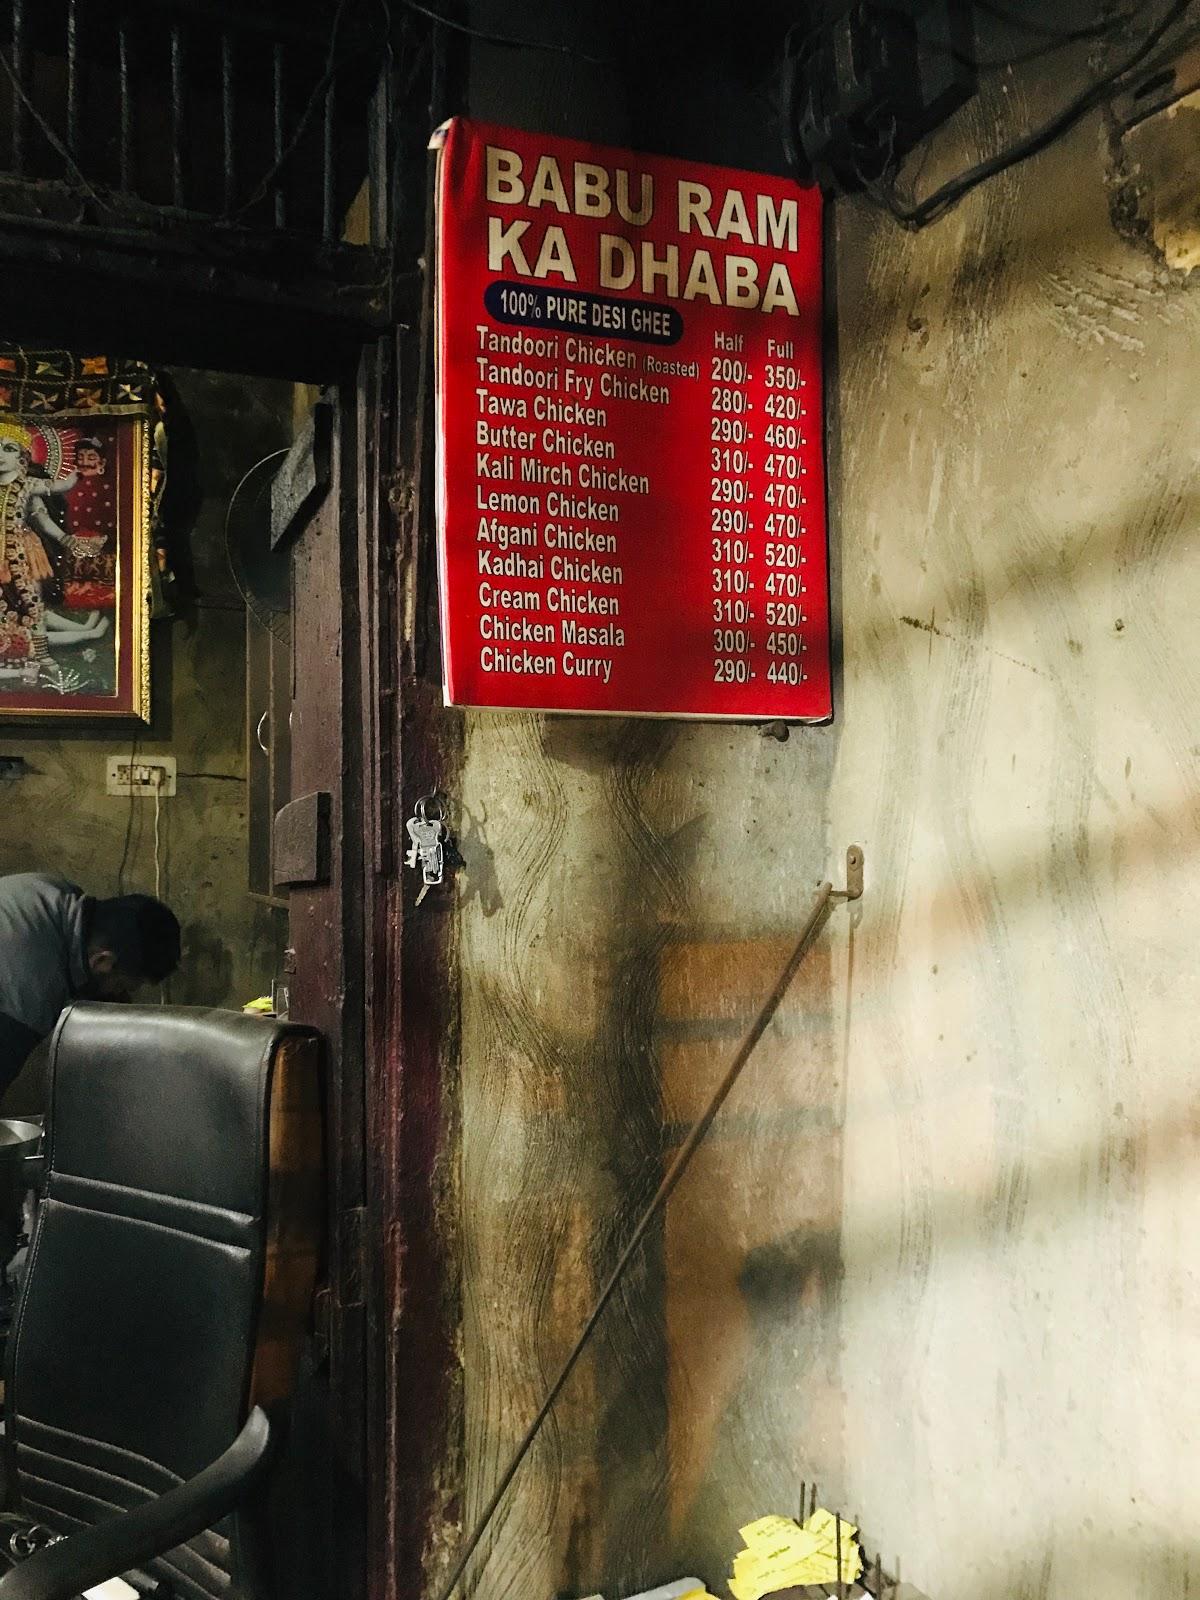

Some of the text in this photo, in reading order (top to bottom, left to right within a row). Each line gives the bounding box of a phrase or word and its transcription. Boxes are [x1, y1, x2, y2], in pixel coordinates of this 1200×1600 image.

[487, 147, 797, 252] BABU RAM
[489, 217, 799, 315] KA DHABA
[501, 289, 670, 336] 100% PURE DESI GHEE
[477, 325, 806, 390] Tandoori Chicken (Roasted) 200/- 350/-
[715, 331, 793, 359] Half Full
[477, 357, 806, 420] Tandoori Fry Chicken 280/- 420/-
[476, 388, 806, 449] Tawa Chicken 290/- 460/-
[477, 421, 806, 479] Butter Chicken 310/- 470/-
[477, 453, 806, 508] Kali Mirch Chicken 290/- 470/-
[478, 485, 806, 538] Lemon Chicken 290/- 470/-
[477, 517, 806, 568] Afgani Chicken 310/- 520/-
[479, 550, 806, 597] Kadhai Chicken 310/- 470/-
[479, 582, 807, 626] Cream Chicken 310/- 520/-
[480, 614, 806, 655] Chicken Masala 300/- 450/-
[481, 647, 807, 685] Chicken Curry 290/- 440/-
